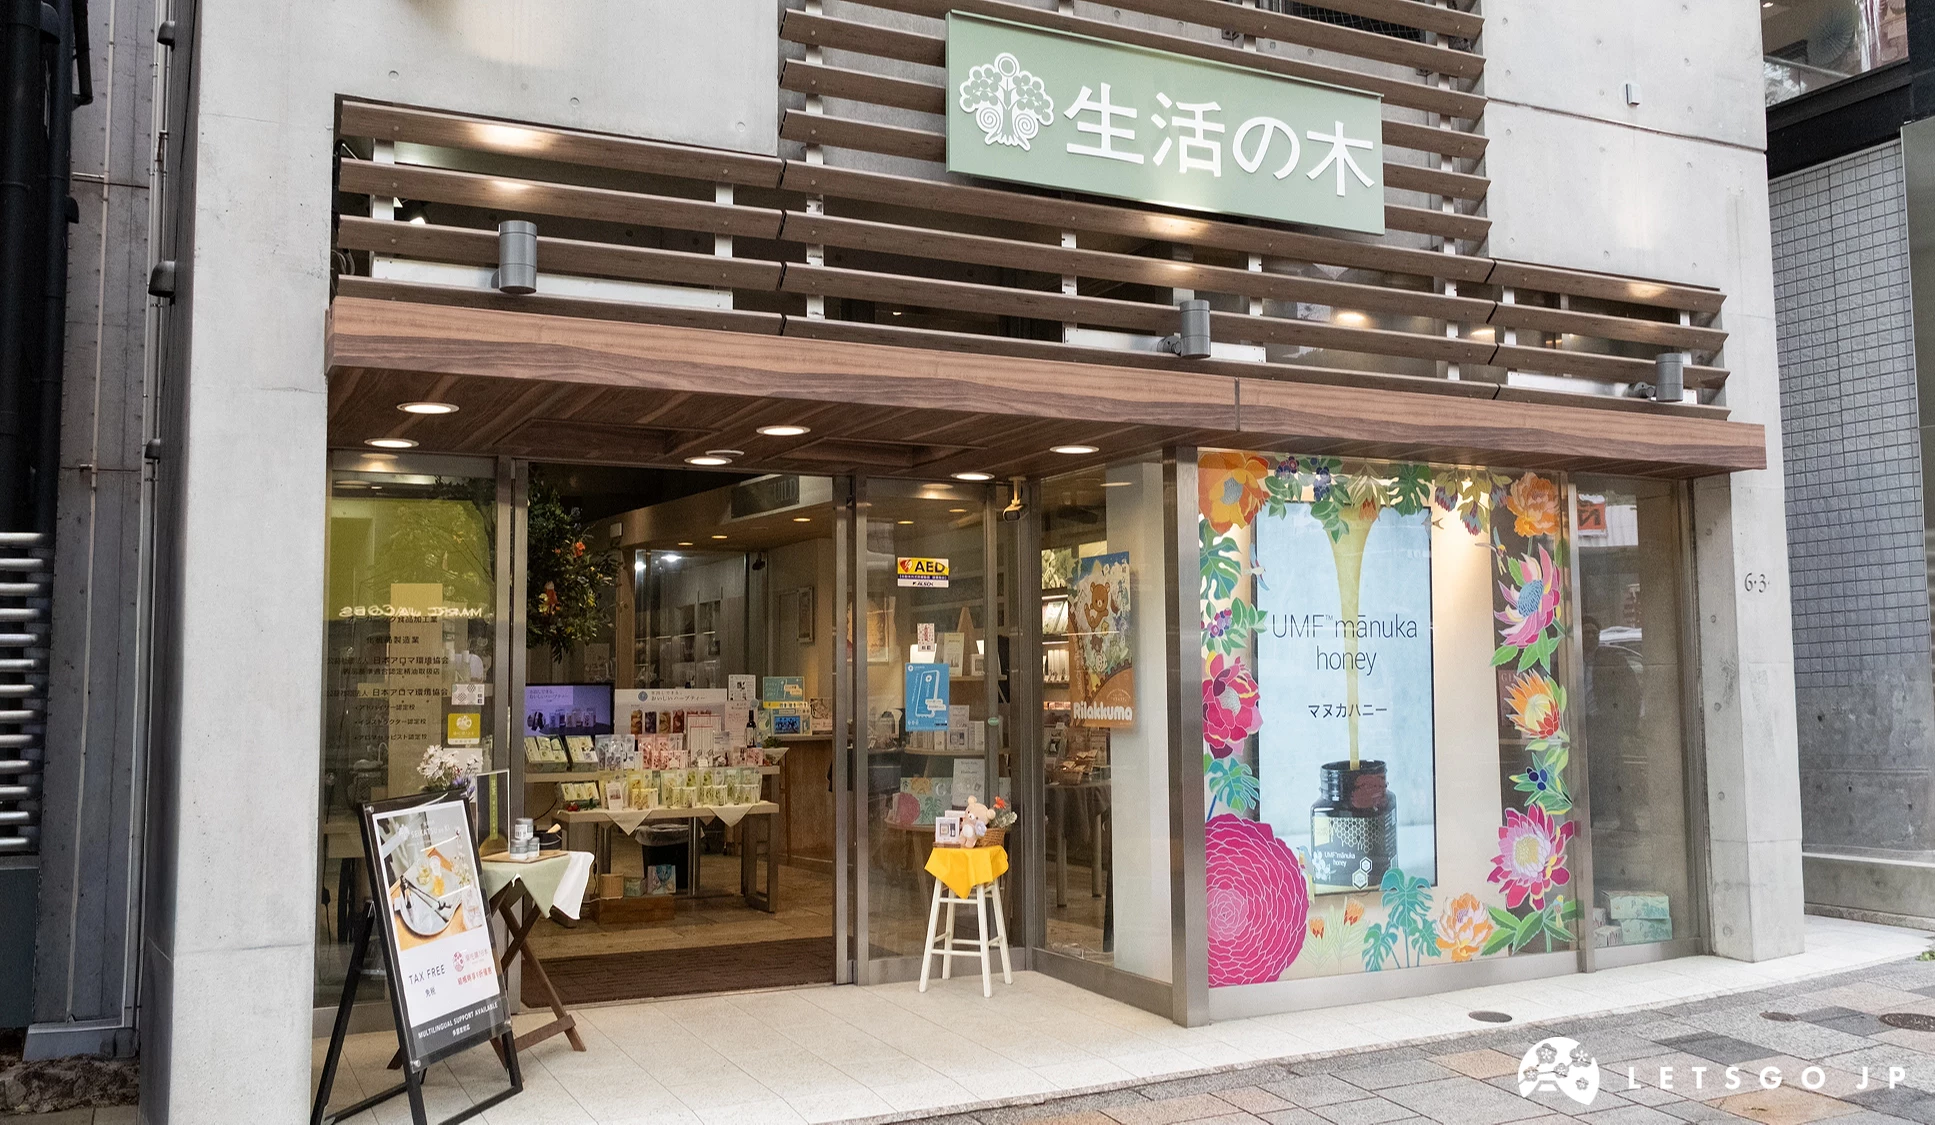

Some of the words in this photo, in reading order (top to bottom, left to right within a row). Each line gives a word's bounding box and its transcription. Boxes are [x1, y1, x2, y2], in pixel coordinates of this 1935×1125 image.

[1063, 83, 1375, 197] 生活の木
[915, 561, 945, 573] AED
[1335, 614, 1418, 638] mānuka
[1316, 645, 1377, 676] honey
[1073, 701, 1133, 721] Rilakkuma
[1308, 704, 1387, 718] マヌカハニー
[409, 971, 425, 985] TAX
[427, 964, 446, 980] FREE
[418, 1020, 453, 1039] MULTILINGUAL
[453, 1011, 474, 1026] SUPPORT
[474, 1001, 498, 1017] AVAILABLE
